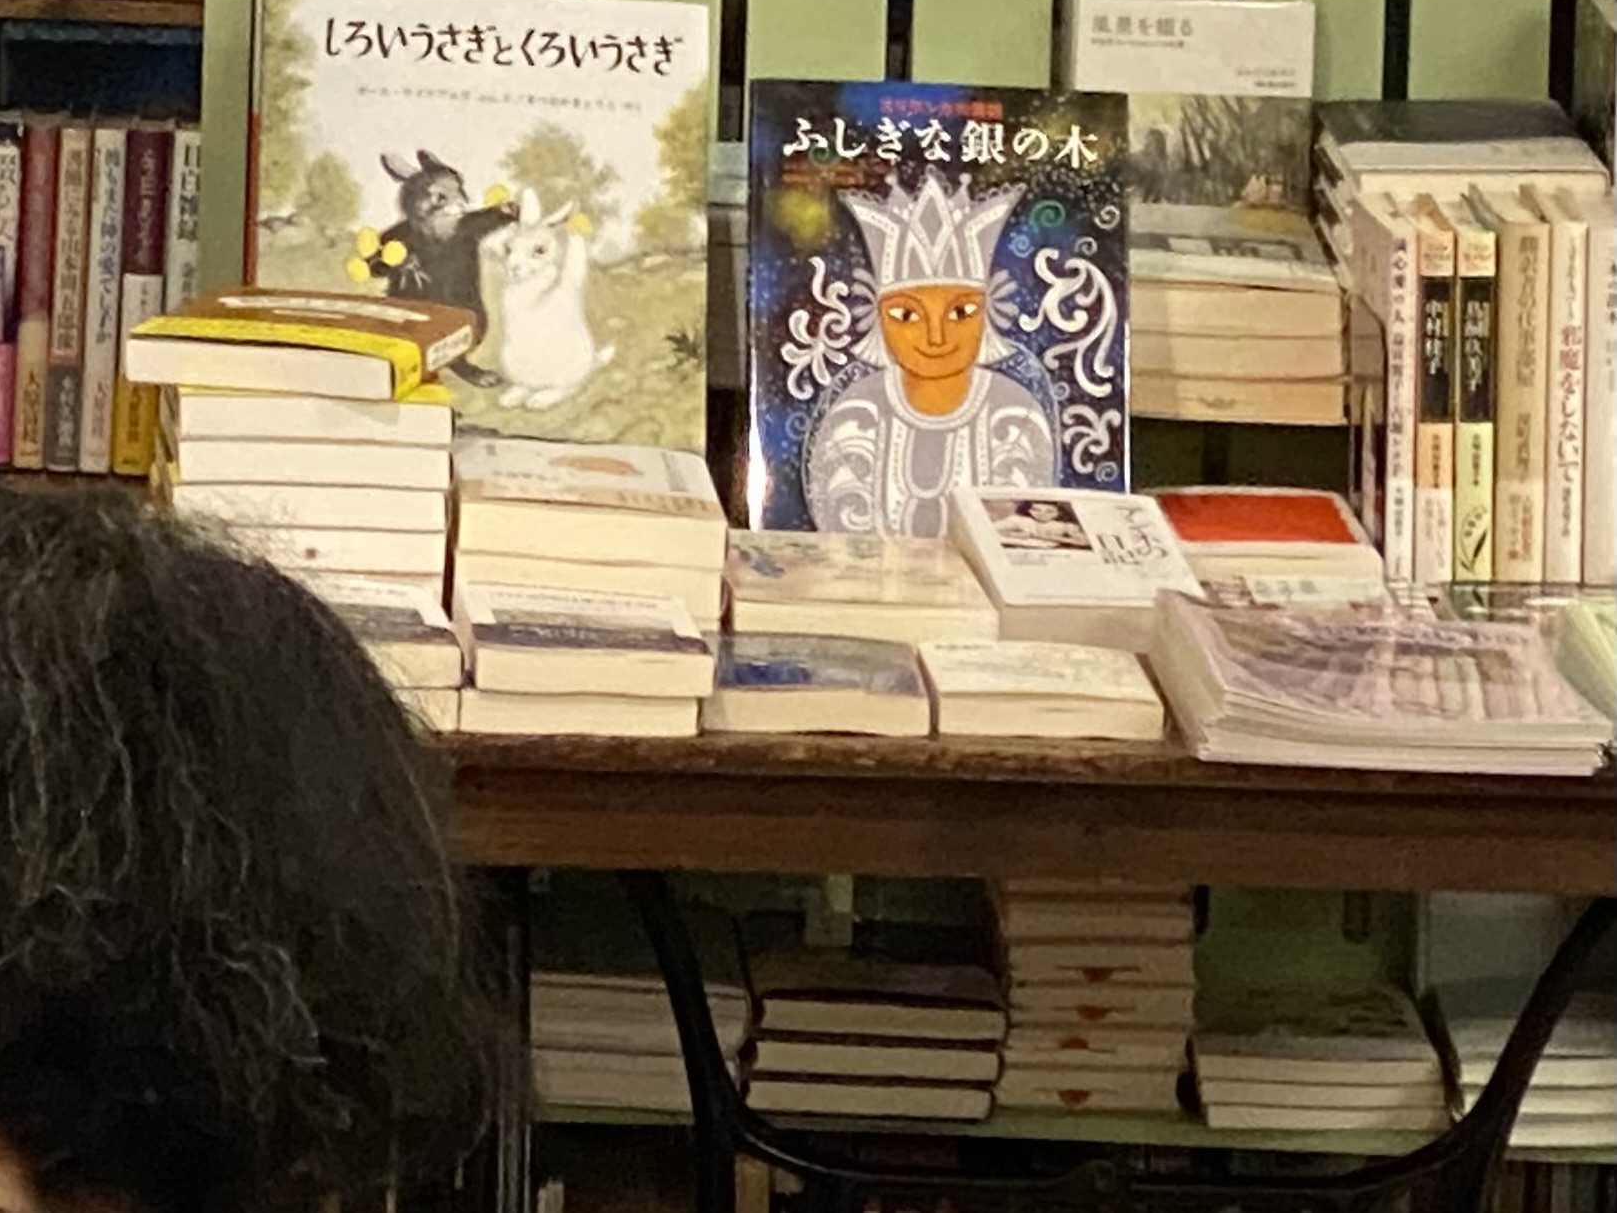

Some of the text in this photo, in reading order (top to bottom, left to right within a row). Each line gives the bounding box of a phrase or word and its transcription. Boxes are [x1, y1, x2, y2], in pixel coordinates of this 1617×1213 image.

[324, 16, 684, 77] しろいうさぎとくろいうさぎ
[781, 116, 1099, 170] ふしぎな銀の木
